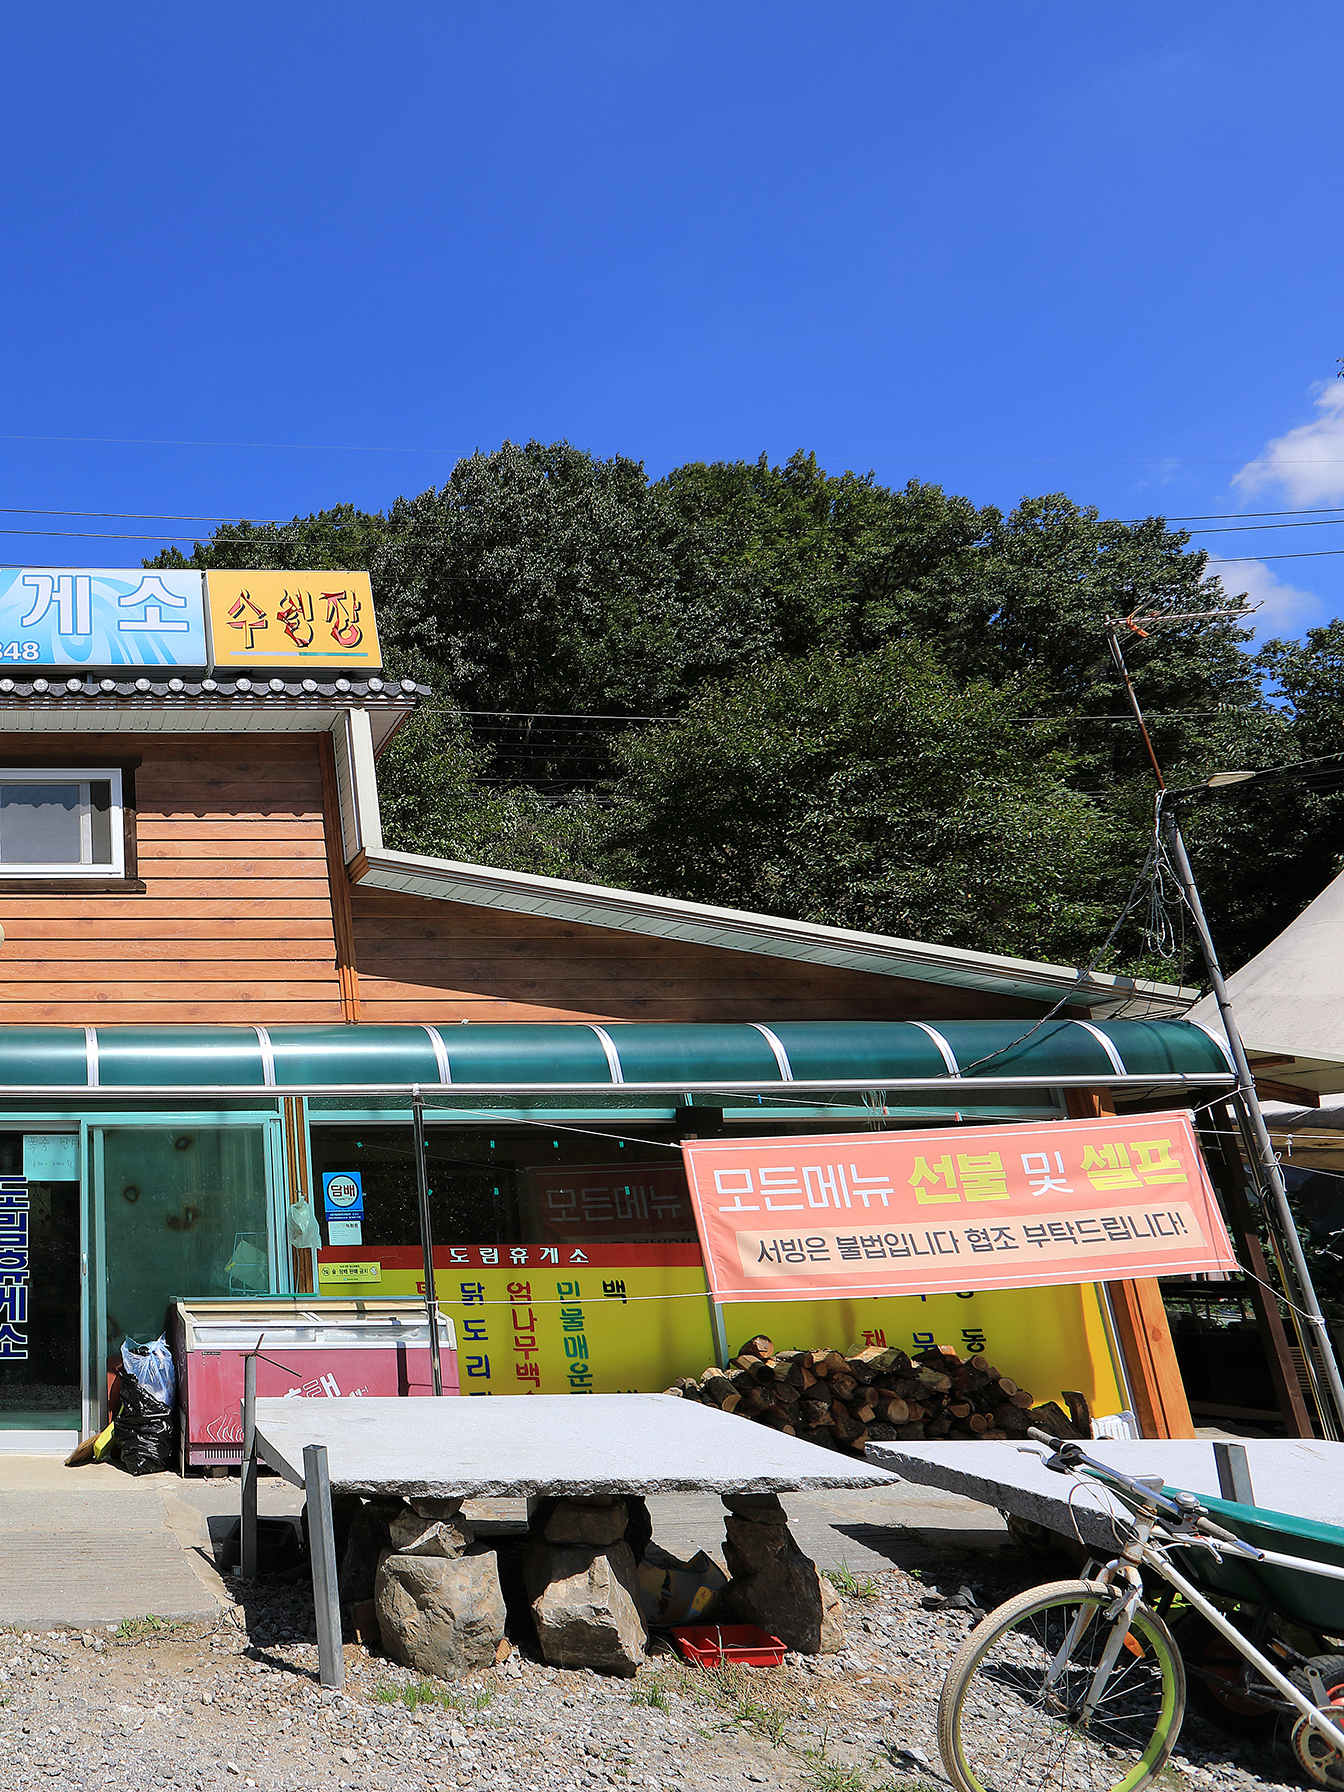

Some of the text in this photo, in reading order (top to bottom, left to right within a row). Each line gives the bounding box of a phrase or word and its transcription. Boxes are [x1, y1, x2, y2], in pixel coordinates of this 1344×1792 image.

[330, 1184, 356, 1197] 담배
[713, 1139, 1188, 1212] 모든메뉴 선불 및 셀프
[449, 1247, 590, 1264] 도림휴게소
[756, 1211, 1189, 1264] 서빙은 불법입니다 협조 부탁드립니다!
[459, 1281, 492, 1395] 닭도리
[506, 1280, 541, 1395] 엄나무백
[556, 1280, 593, 1395] 민물매운
